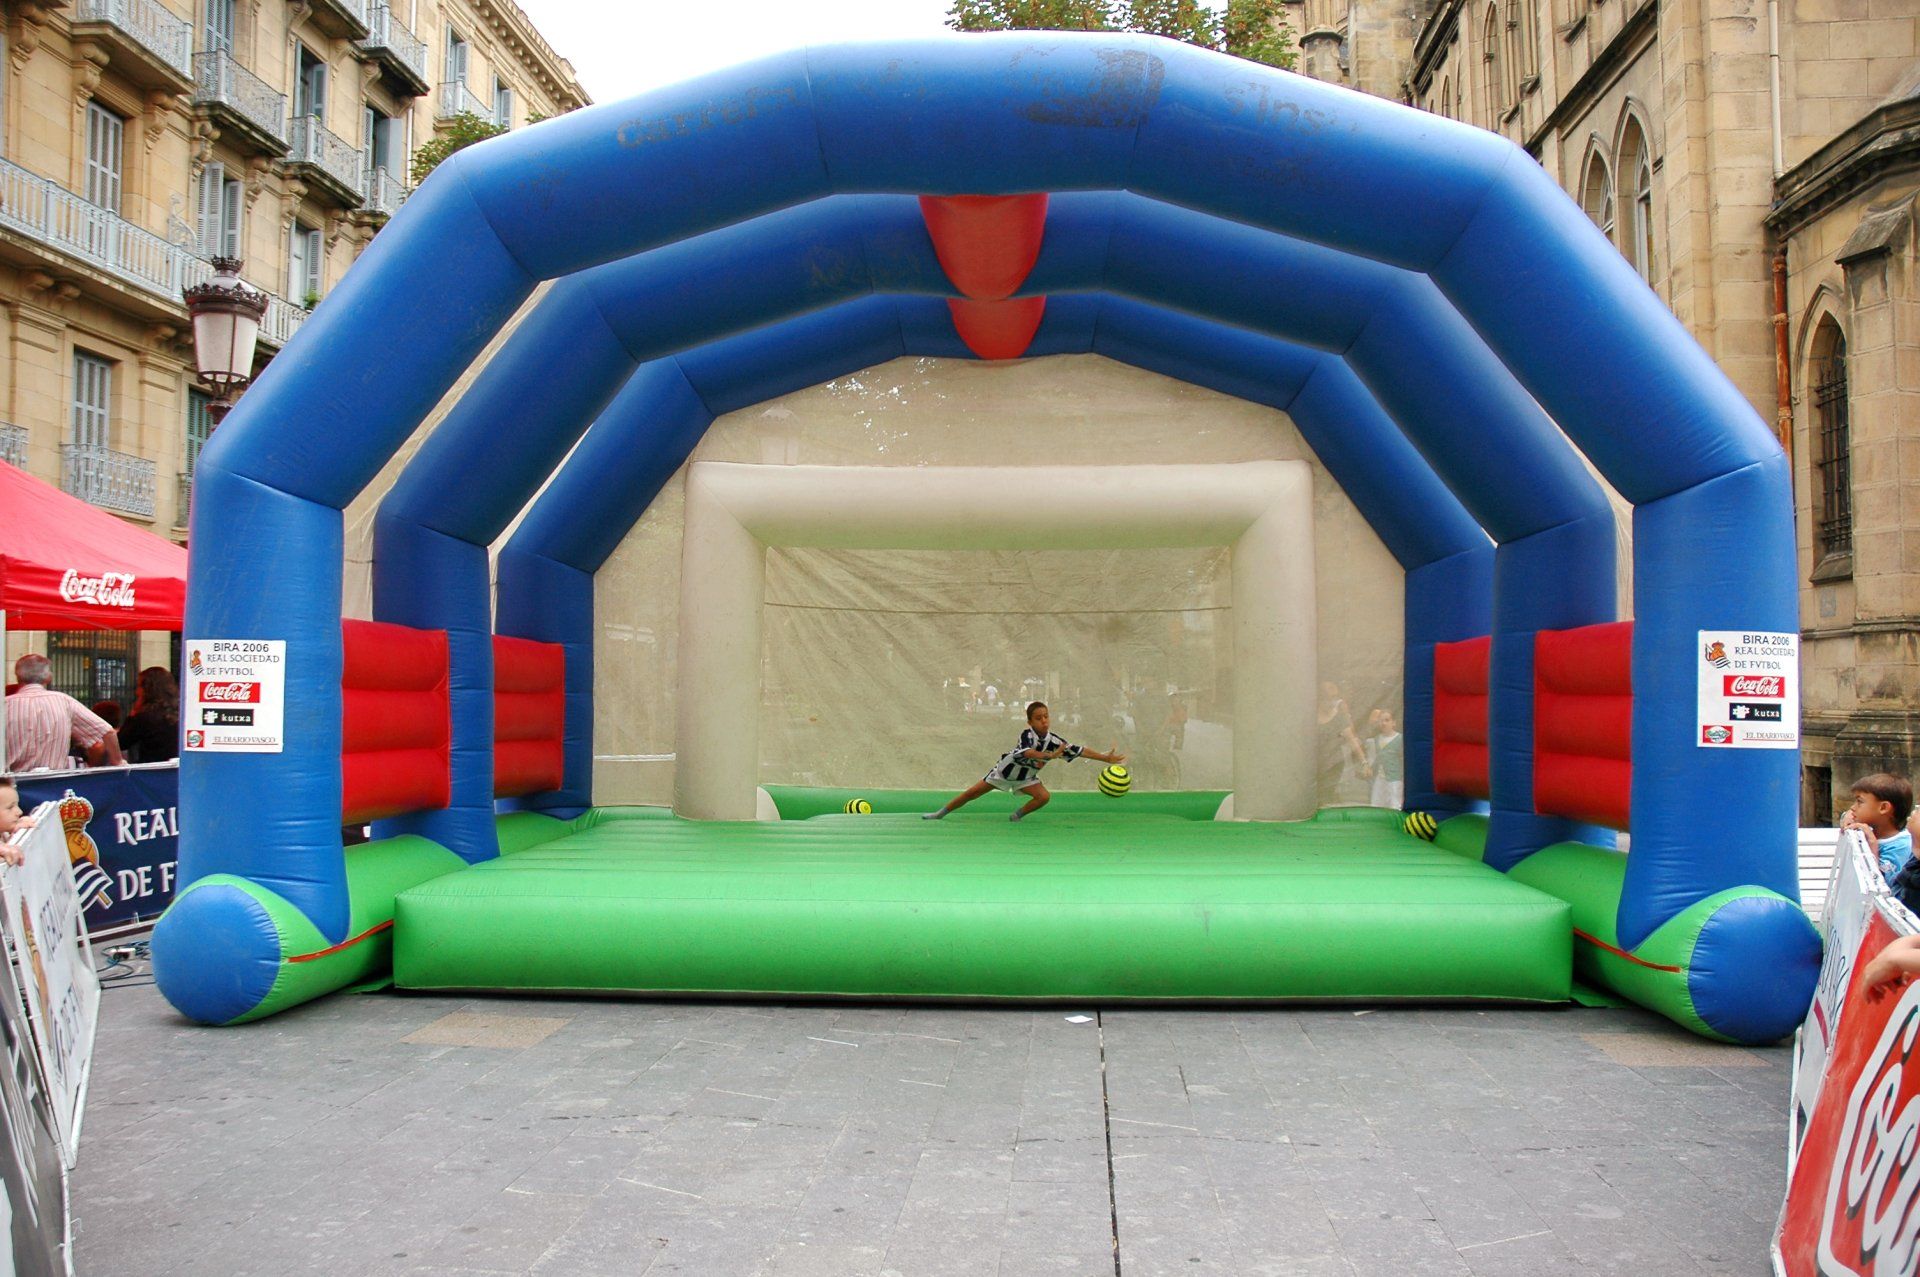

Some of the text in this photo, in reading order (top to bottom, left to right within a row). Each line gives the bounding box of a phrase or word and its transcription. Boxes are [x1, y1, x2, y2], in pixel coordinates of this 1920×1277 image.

[1742, 635, 1790, 646] BIRA 2006
[213, 643, 270, 653] BIRA 2006
[1735, 647, 1795, 657] REAL SOCIEDAD
[207, 654, 280, 663] REAL SOCIEDAD
[1735, 661, 1747, 669] DE
[207, 668, 217, 676] DE
[222, 713, 252, 723] kutxa
[1754, 708, 1781, 718] kutxa
[114, 806, 180, 846] REAL
[117, 860, 179, 901] DE F
